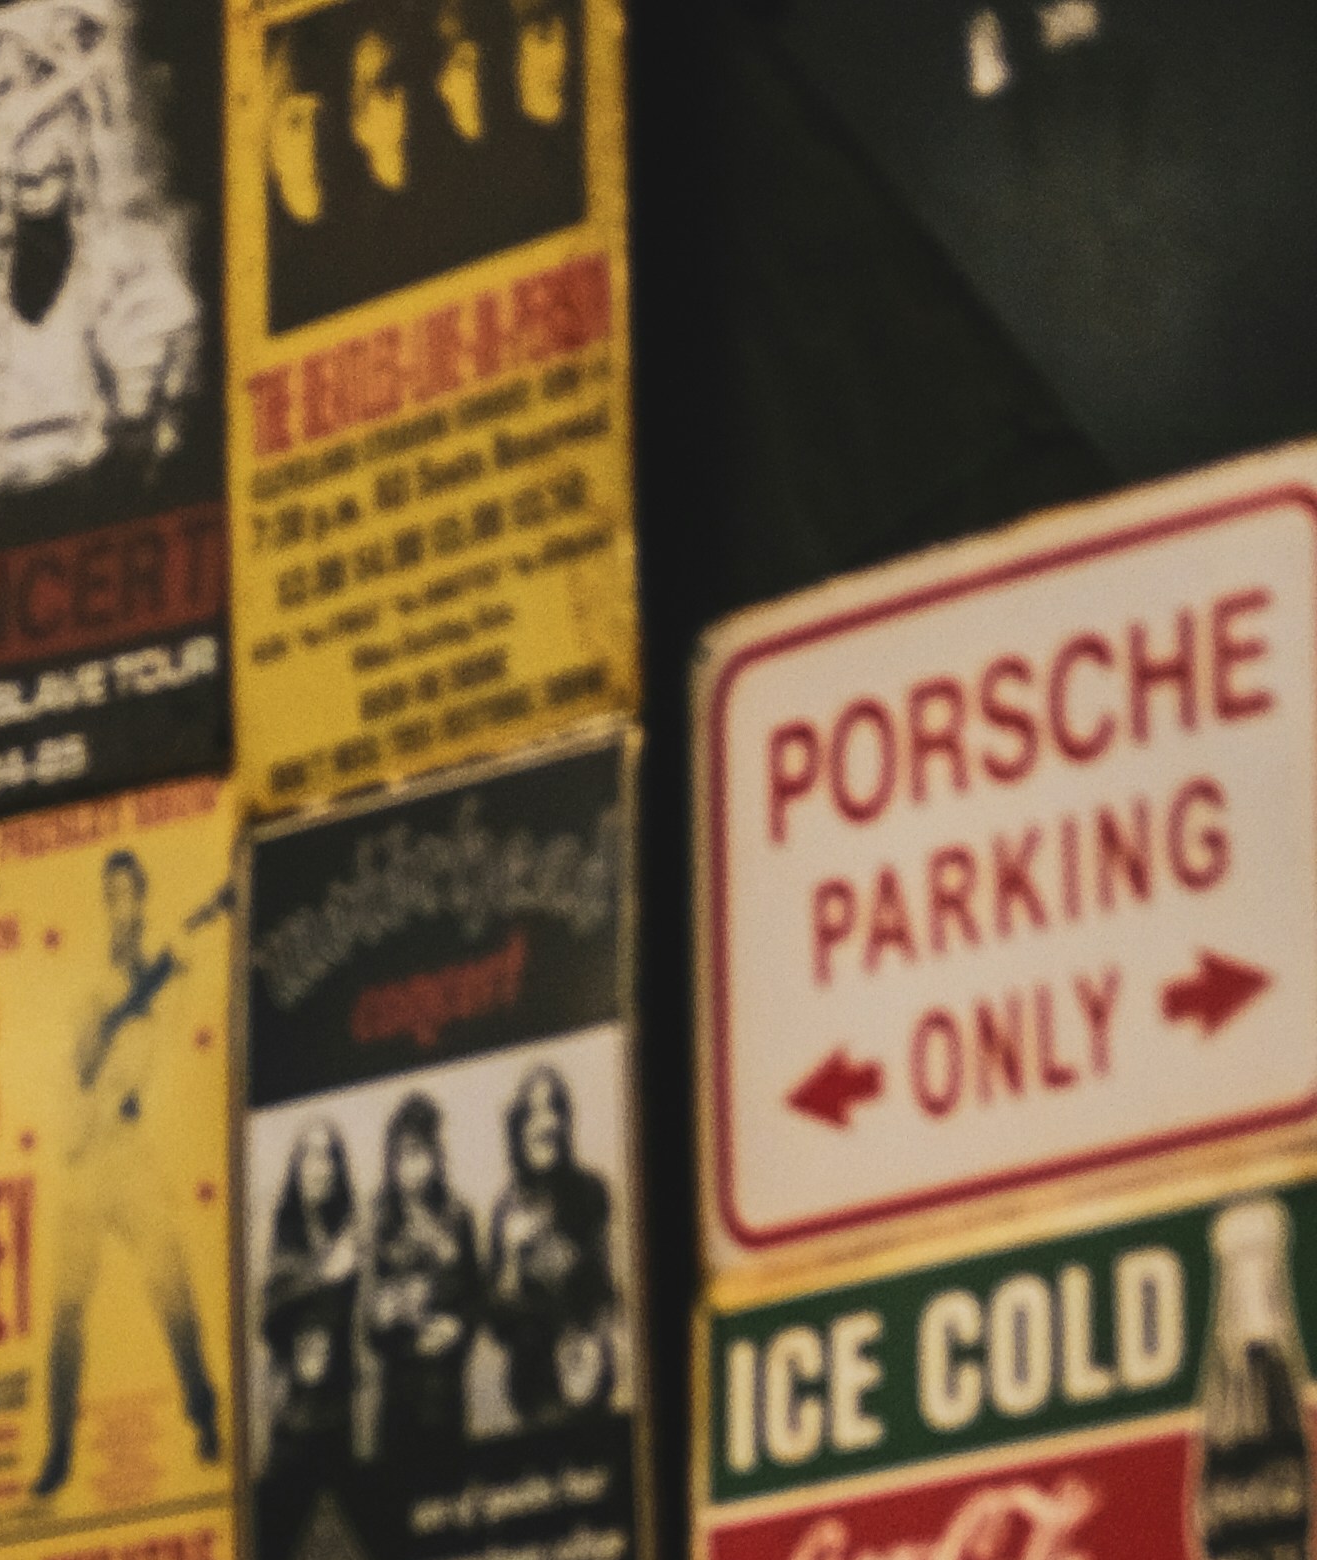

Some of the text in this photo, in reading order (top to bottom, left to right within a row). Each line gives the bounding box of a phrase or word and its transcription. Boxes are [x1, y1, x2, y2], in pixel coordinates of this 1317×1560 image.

[767, 586, 1275, 844] PORSCHE
[810, 778, 1233, 985] PARKING
[910, 964, 1121, 1119] ONLY
[725, 1246, 1184, 1476] ICE COLD
